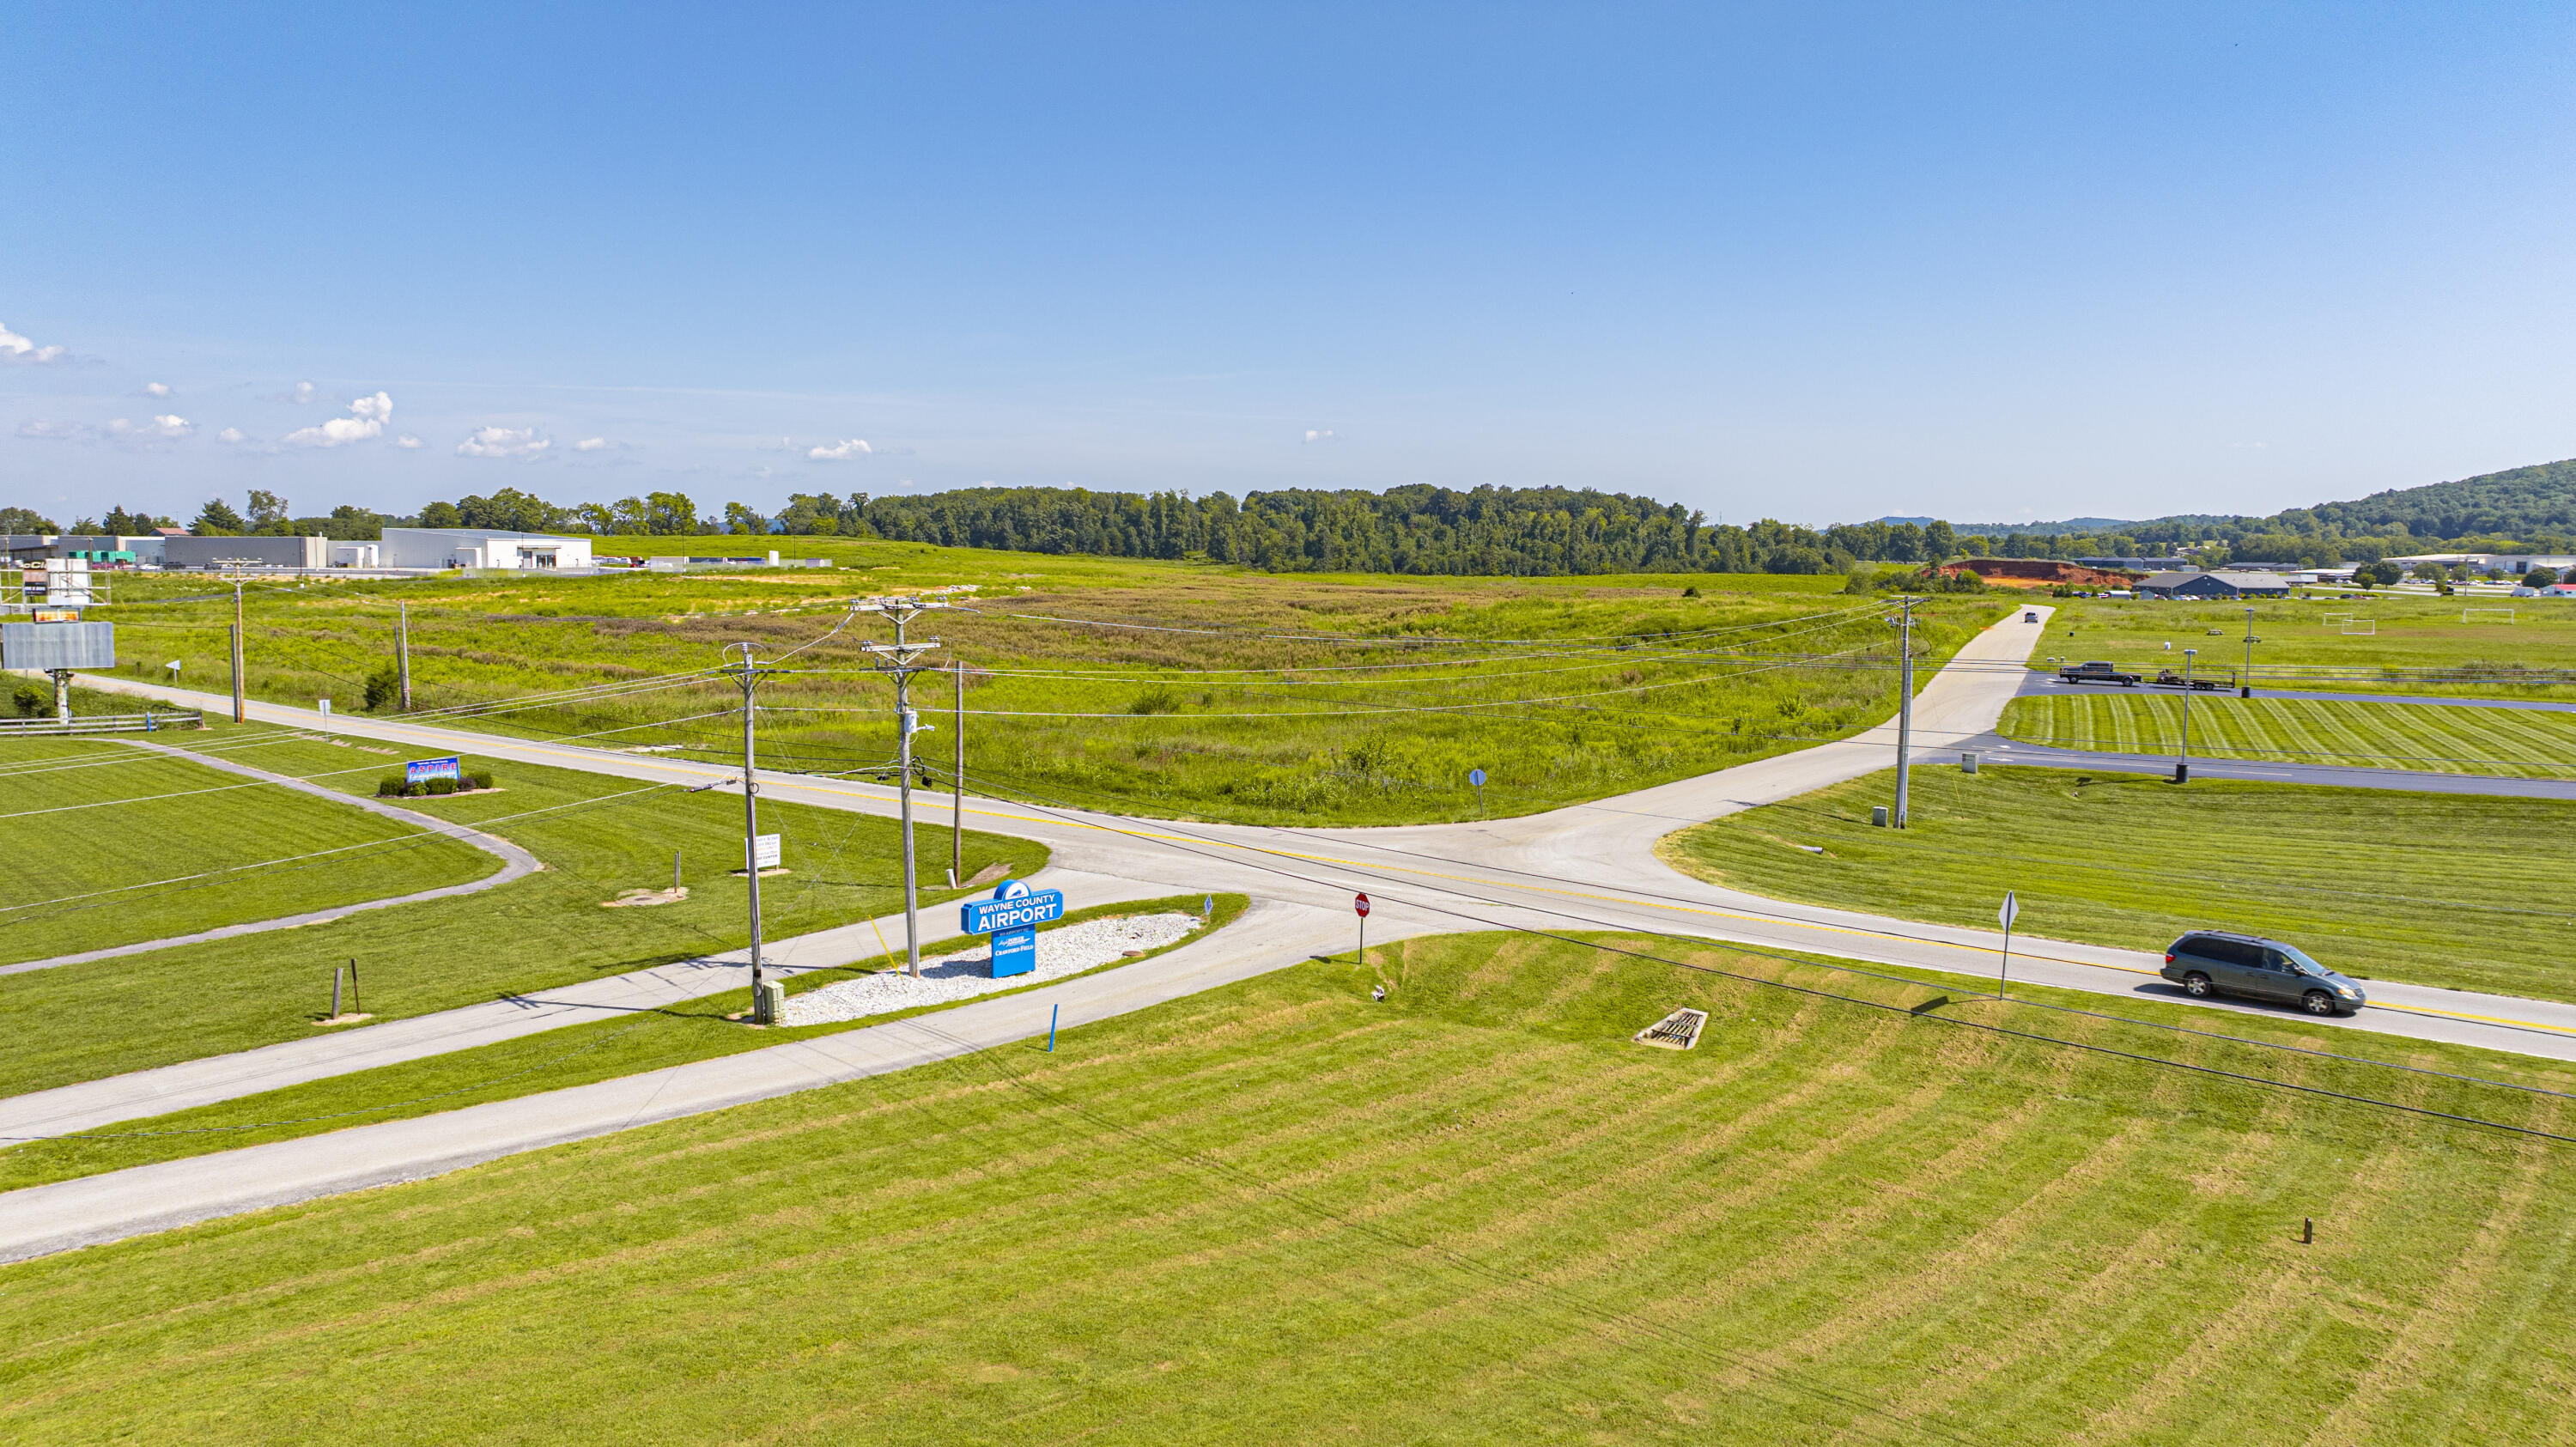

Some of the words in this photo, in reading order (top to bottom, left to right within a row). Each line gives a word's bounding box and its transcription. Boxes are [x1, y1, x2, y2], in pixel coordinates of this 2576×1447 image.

[410, 762, 457, 774] ASPIRE
[979, 901, 1013, 915] WAYNE
[1015, 894, 1055, 908] COUNTY
[1355, 899, 1370, 911] STOP
[978, 903, 1057, 931] AIRPORT
